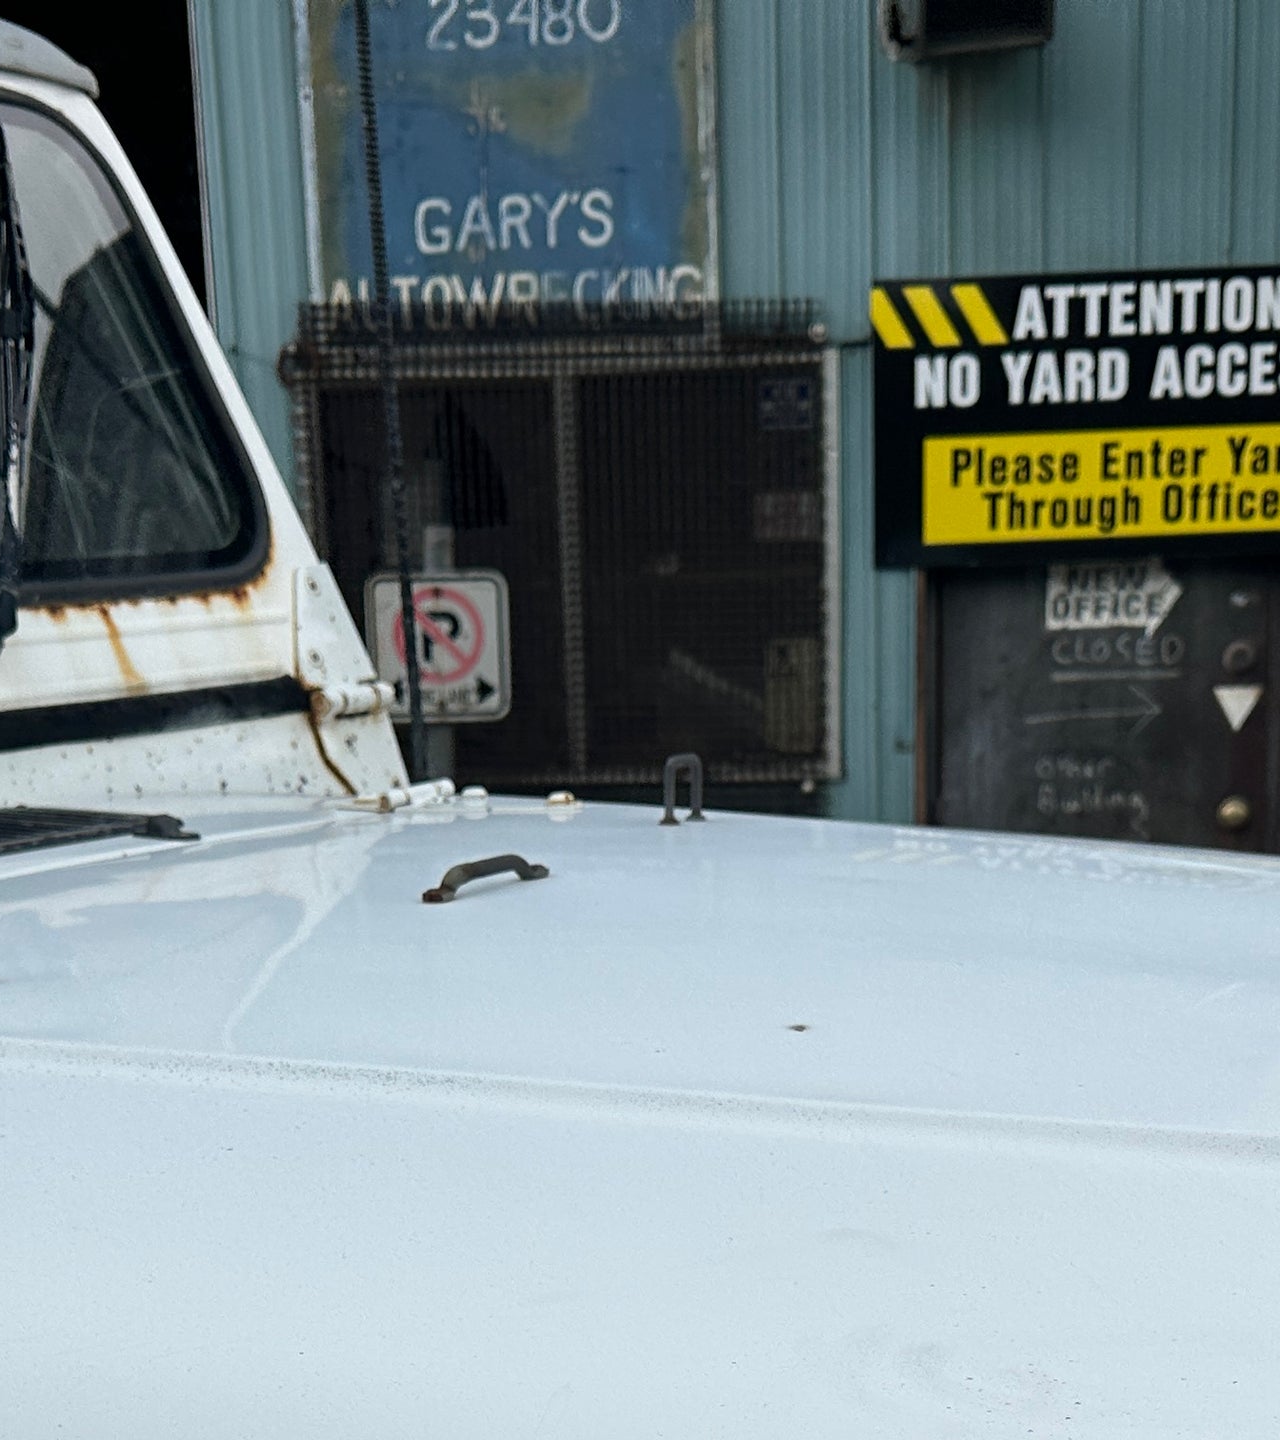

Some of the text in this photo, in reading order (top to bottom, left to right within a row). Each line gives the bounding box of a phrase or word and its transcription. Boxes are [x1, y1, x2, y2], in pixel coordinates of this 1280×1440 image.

[427, 0, 621, 49] 23480
[414, 189, 614, 256] GARY'S
[913, 353, 981, 409] NO
[1001, 346, 1130, 405] YARD
[950, 446, 1079, 488] Please
[1100, 440, 1208, 484] Enter
[982, 483, 1280, 535] Through Office
[1052, 593, 1162, 622] OFFICE
[1052, 631, 1186, 667] CLOSED
